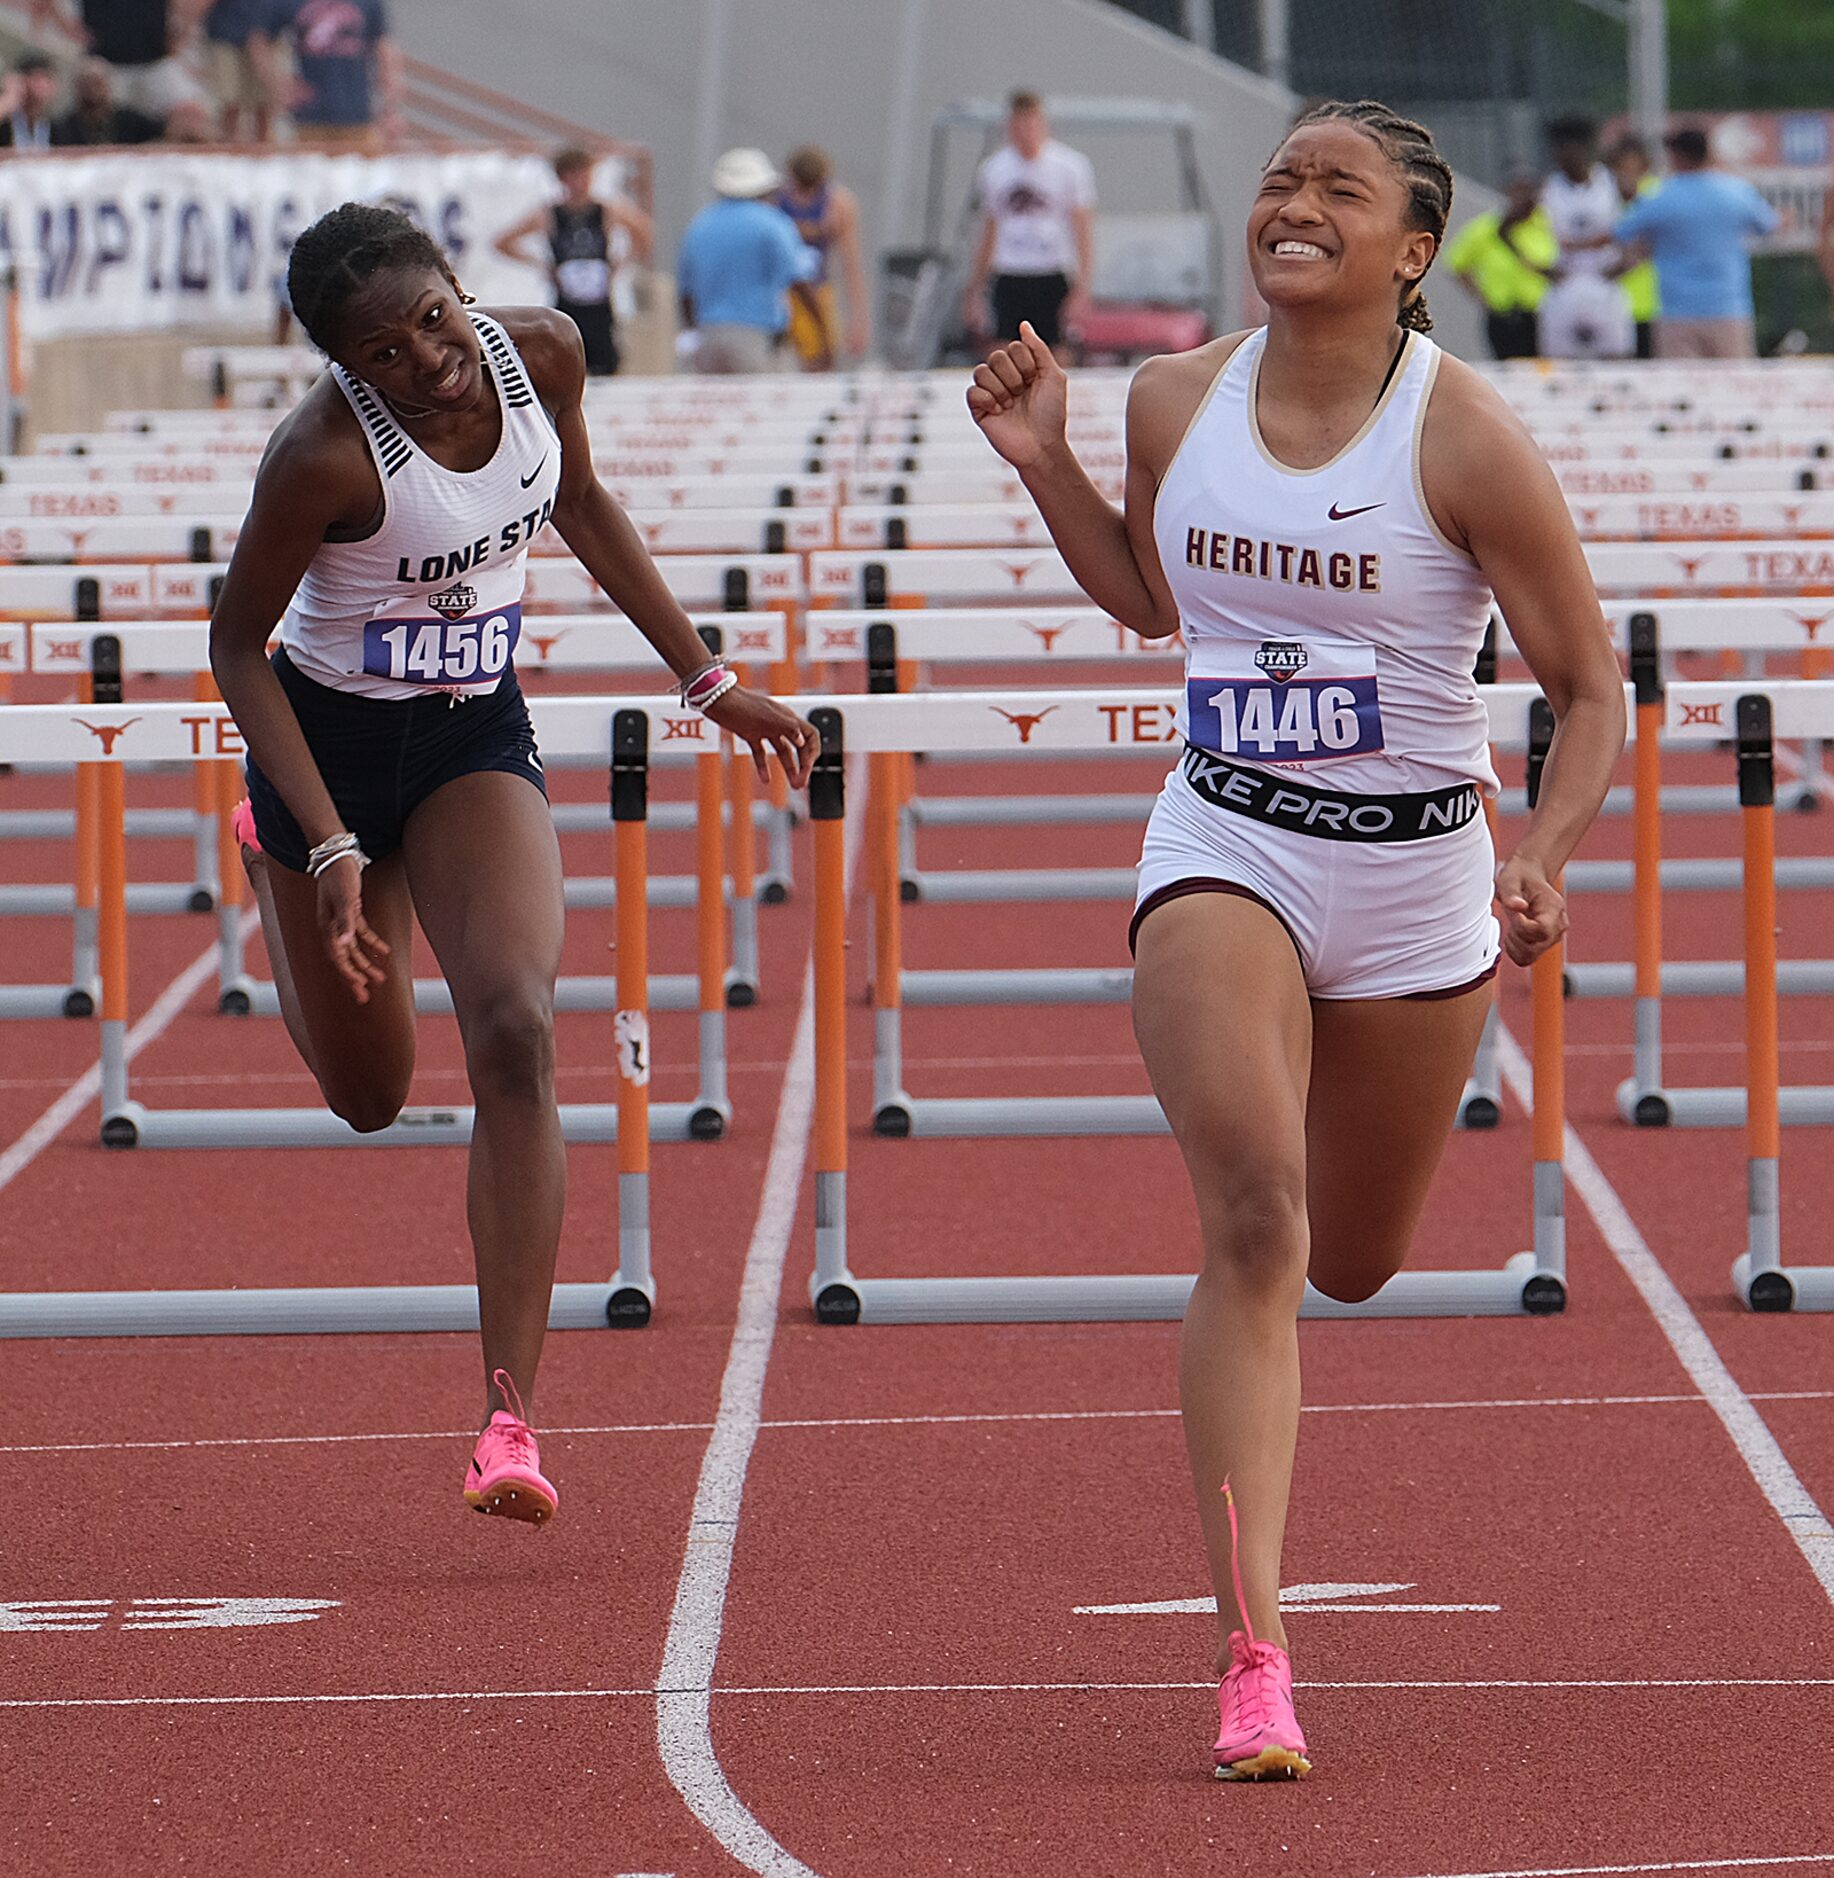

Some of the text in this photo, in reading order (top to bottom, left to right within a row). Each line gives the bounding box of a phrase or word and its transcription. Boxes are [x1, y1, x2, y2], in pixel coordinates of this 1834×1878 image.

[397, 535, 491, 583] LONE
[500, 498, 552, 552] STA
[1186, 526, 1382, 593] HERITAGE
[1744, 552, 1834, 579] TEXA
[429, 593, 477, 606] STATE
[382, 615, 510, 679] 1456
[1255, 651, 1307, 665] STATE
[661, 717, 705, 740] XII
[1208, 686, 1361, 753] 1446
[1680, 703, 1724, 726] XII
[1264, 790, 1394, 833] PRO
[1418, 788, 1478, 830] NIK
